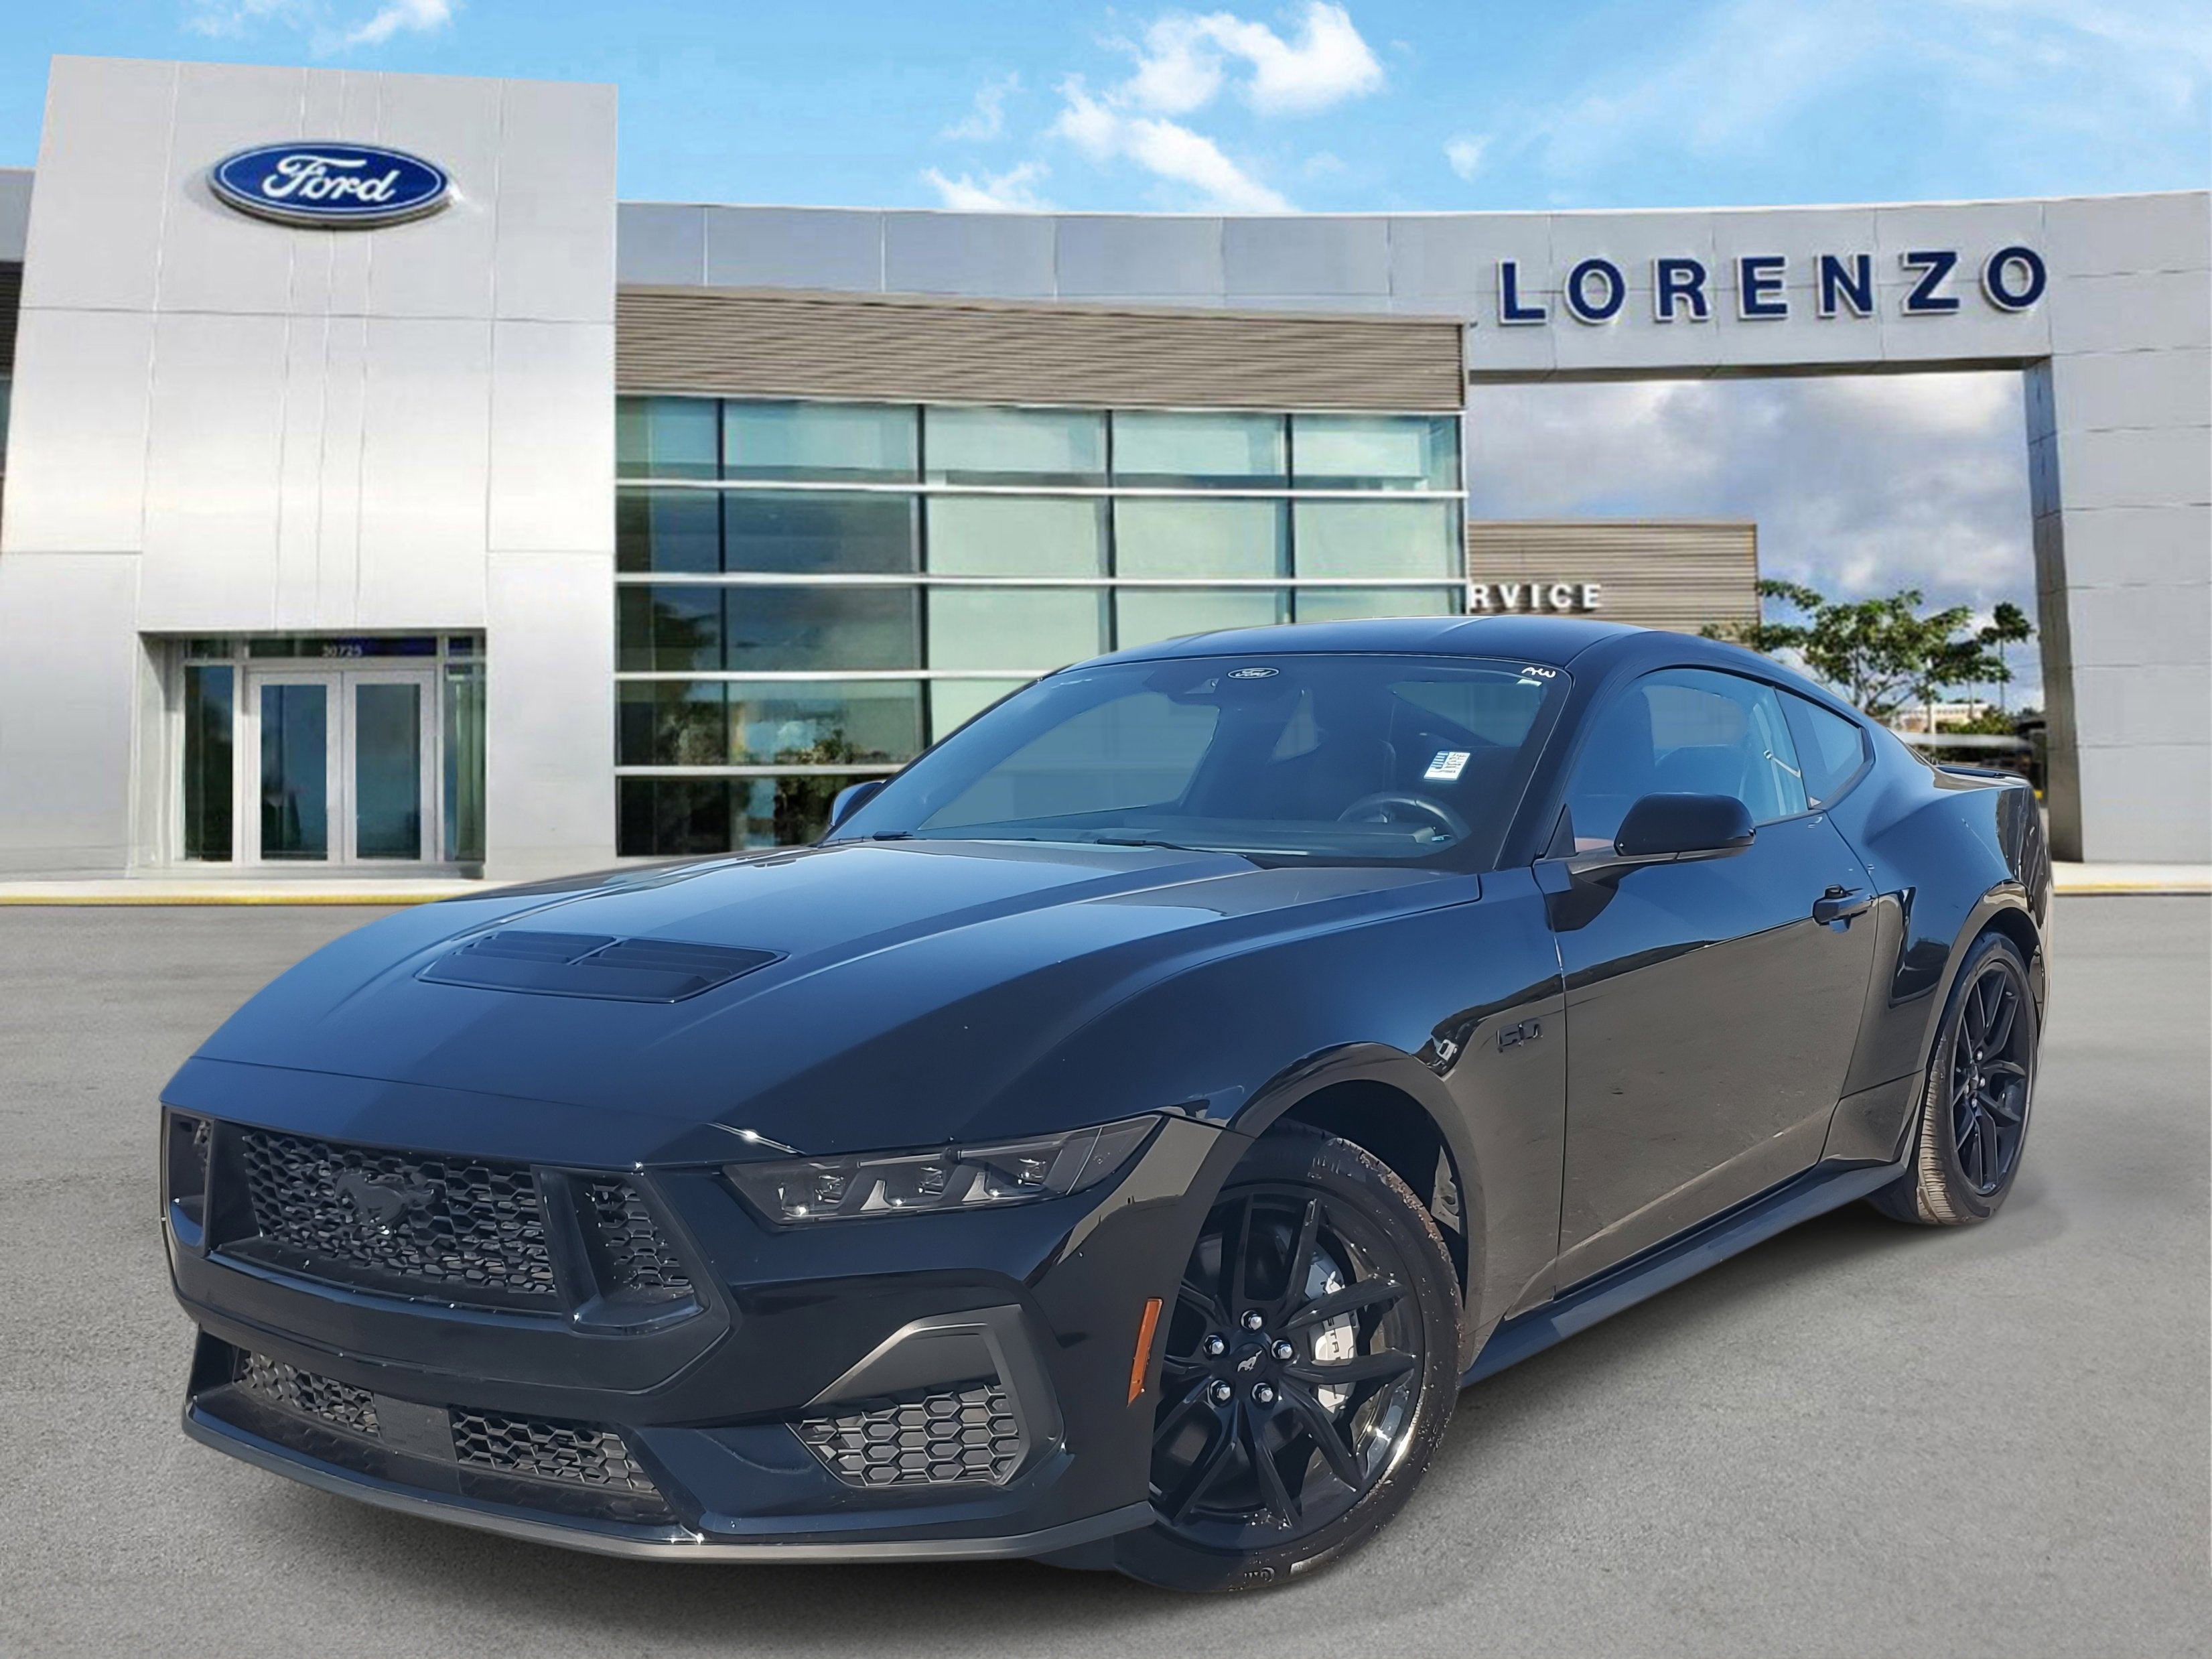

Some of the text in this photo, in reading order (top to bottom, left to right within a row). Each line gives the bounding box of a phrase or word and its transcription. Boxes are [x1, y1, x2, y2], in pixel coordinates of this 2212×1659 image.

[262, 154, 401, 202] Ford
[1497, 245, 2047, 326] LORENZO
[1470, 584, 1602, 608] RVICE
